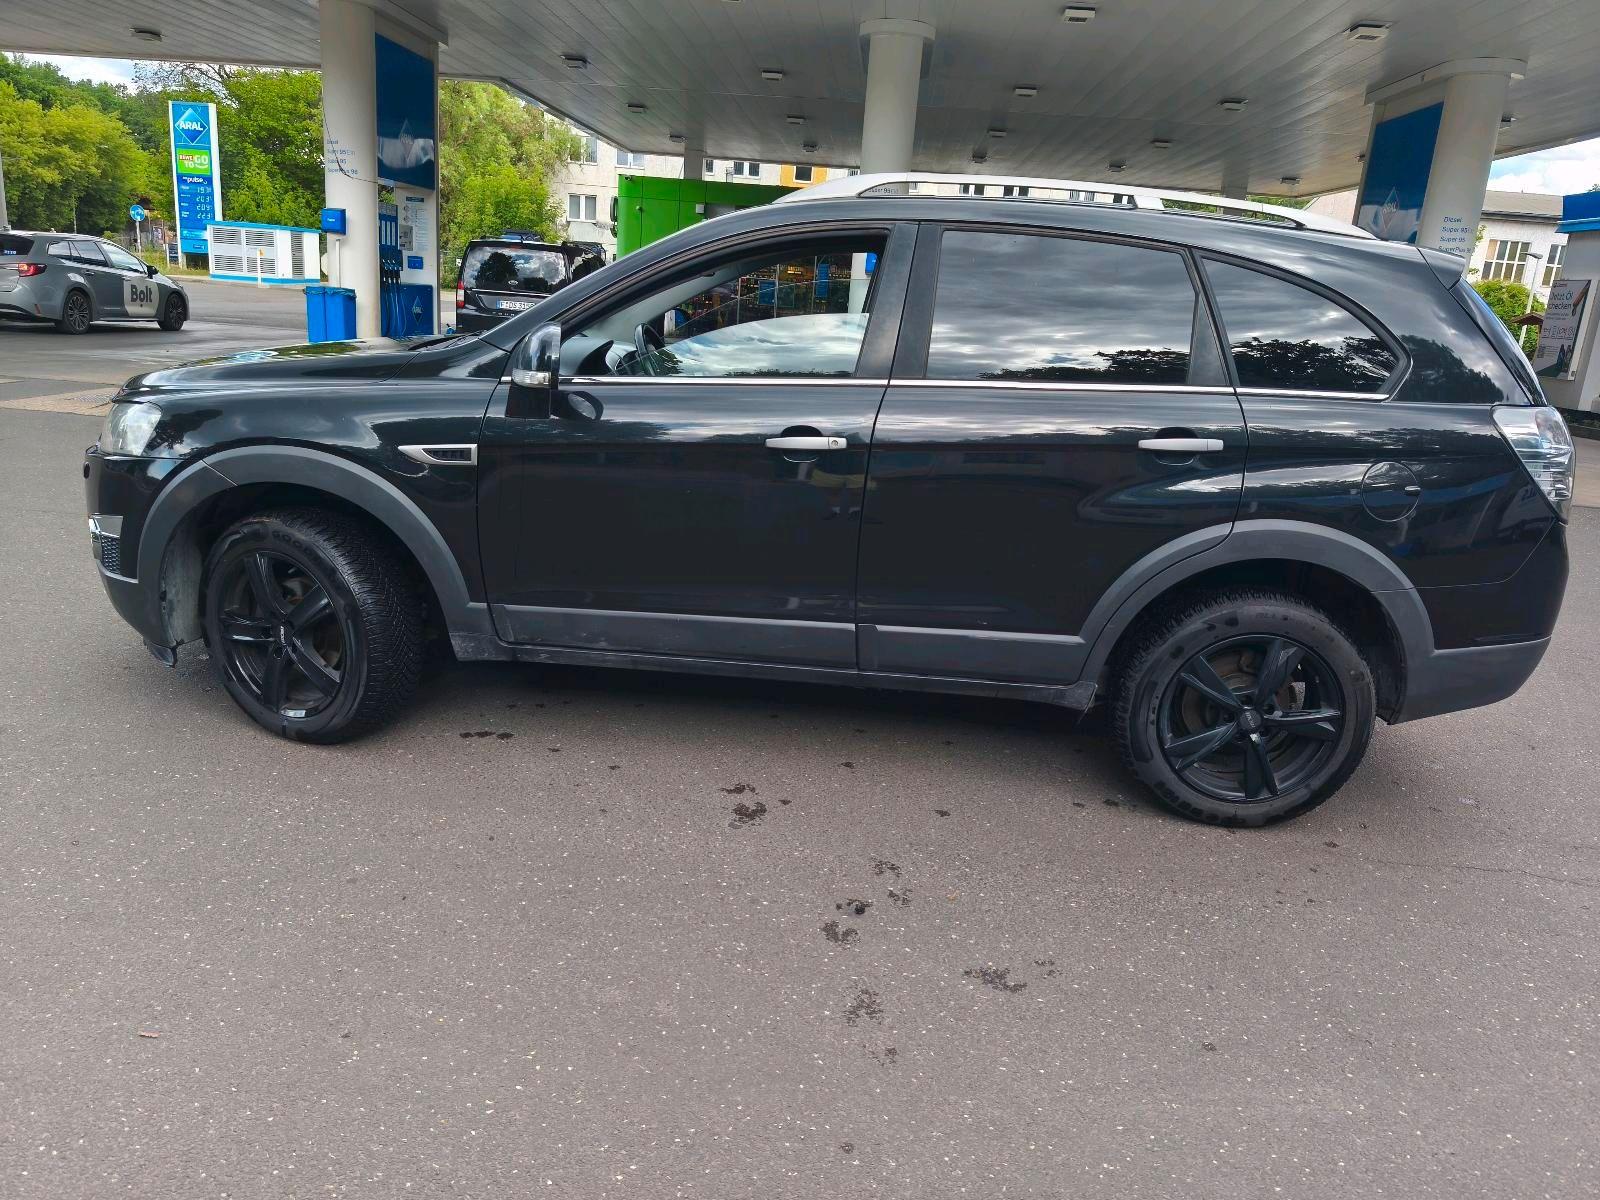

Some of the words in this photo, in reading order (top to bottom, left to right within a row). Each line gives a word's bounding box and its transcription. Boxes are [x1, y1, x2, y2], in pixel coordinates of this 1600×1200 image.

[180, 120, 204, 131] ARAL
[195, 154, 209, 165] GO
[130, 284, 152, 302] Bolt
